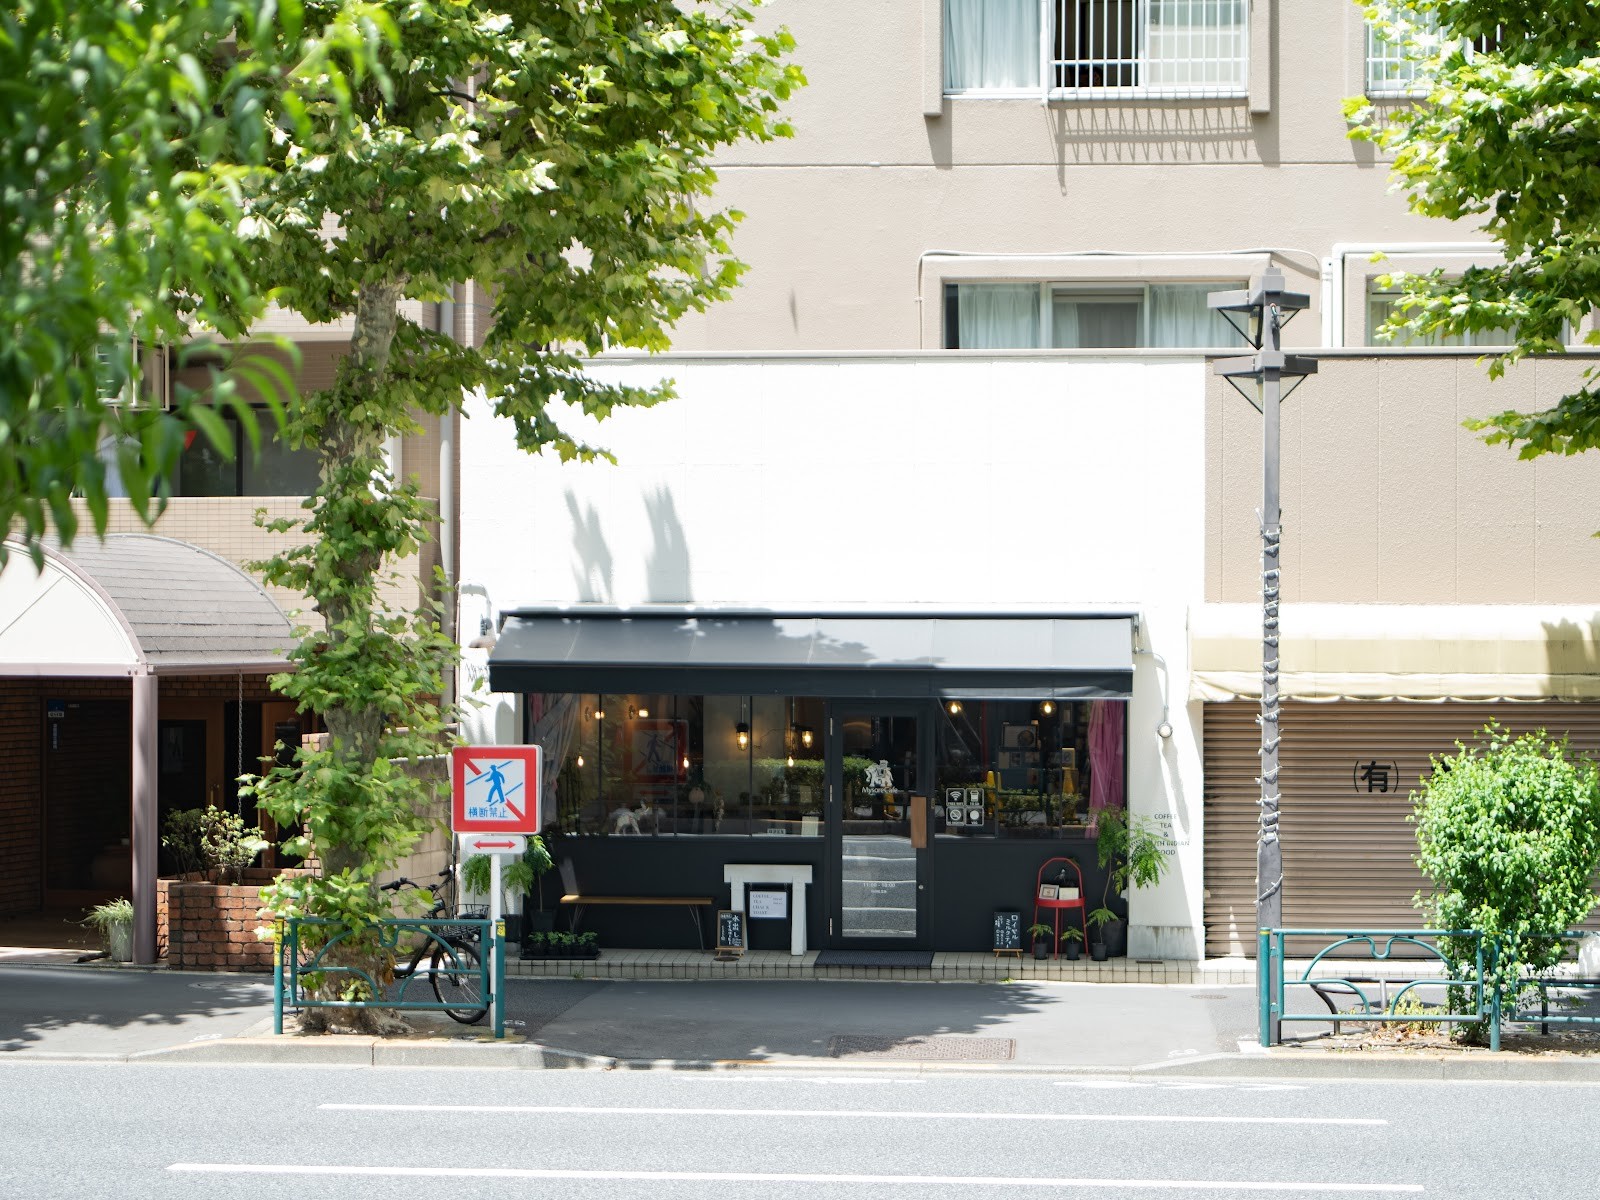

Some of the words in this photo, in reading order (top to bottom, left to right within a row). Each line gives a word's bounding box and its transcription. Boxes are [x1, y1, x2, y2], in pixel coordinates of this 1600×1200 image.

[468, 806, 513, 818] 横断禁止
[732, 914, 740, 938] 水出し
[1011, 914, 1019, 940] ロイヤル
